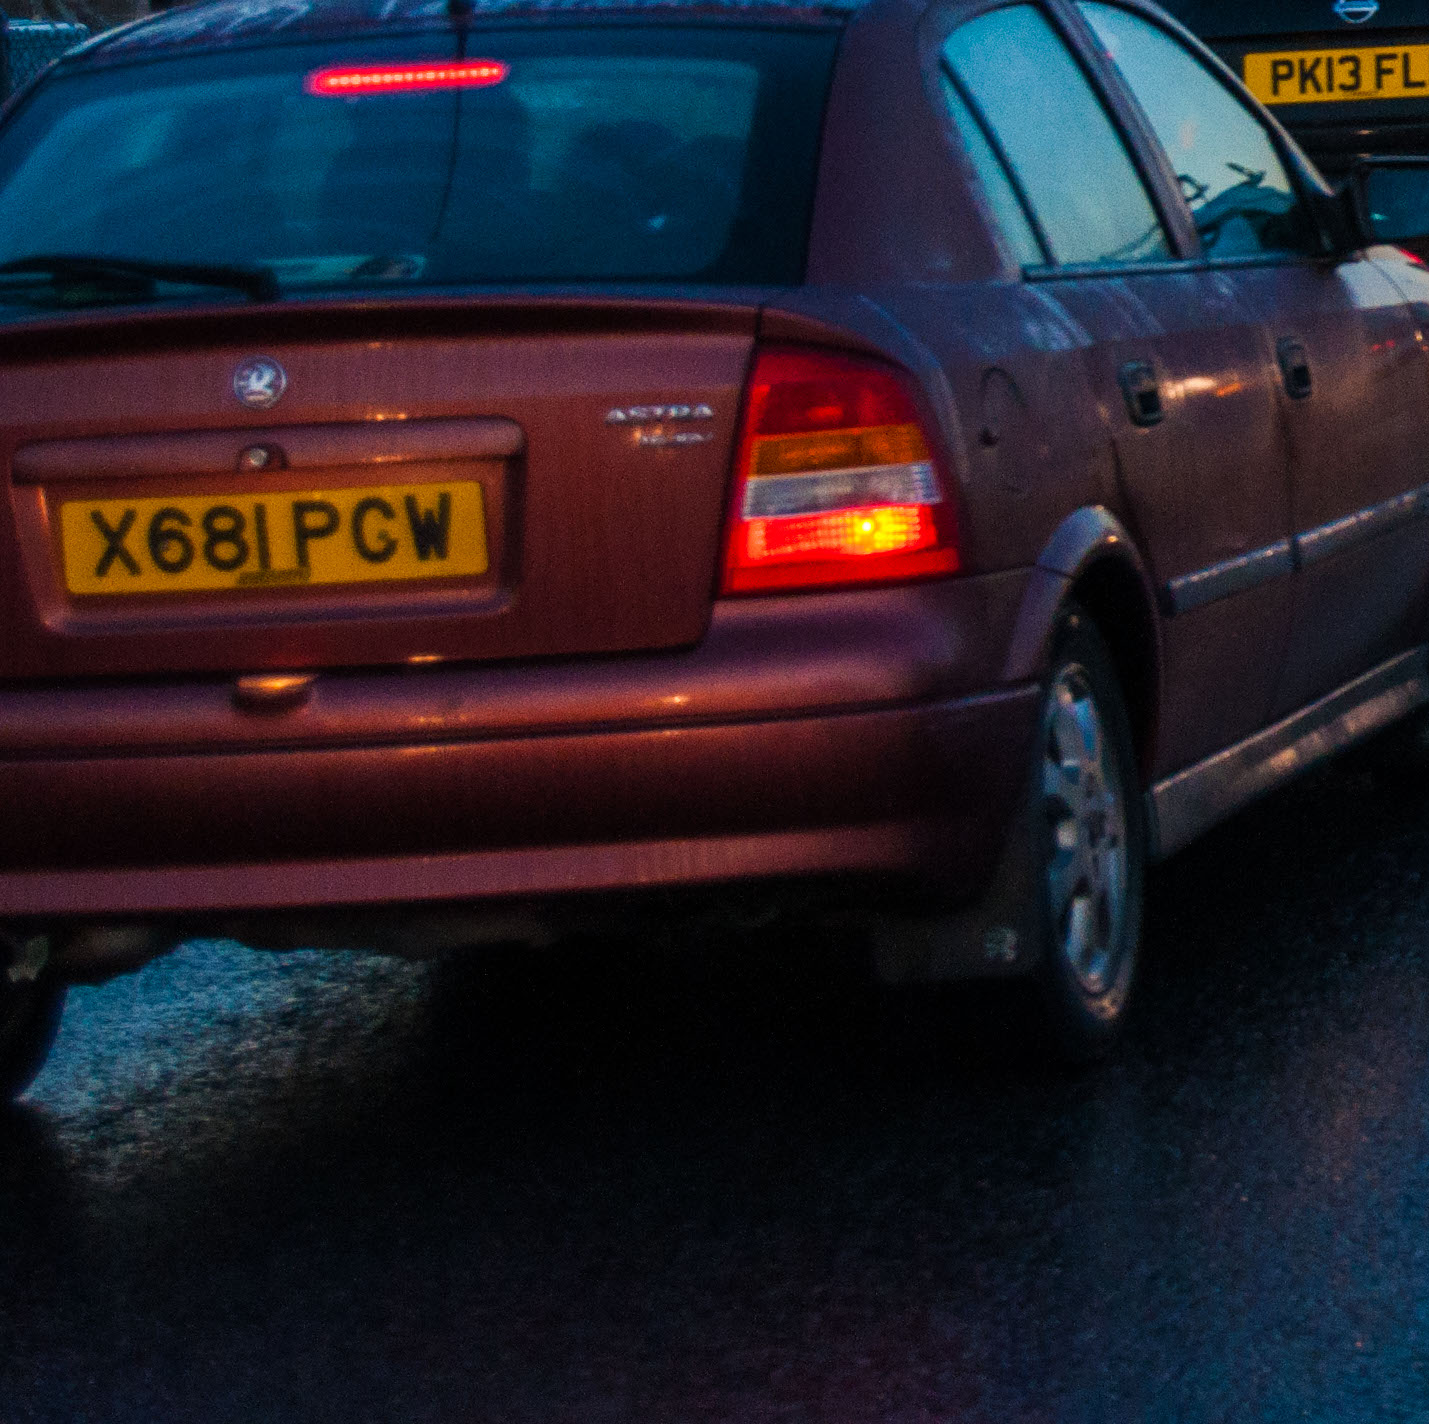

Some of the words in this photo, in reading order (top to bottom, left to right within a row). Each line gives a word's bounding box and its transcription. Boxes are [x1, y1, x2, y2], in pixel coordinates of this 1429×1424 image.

[1271, 55, 1362, 96] PK13
[90, 502, 271, 576] X681
[293, 492, 452, 569] PGW
